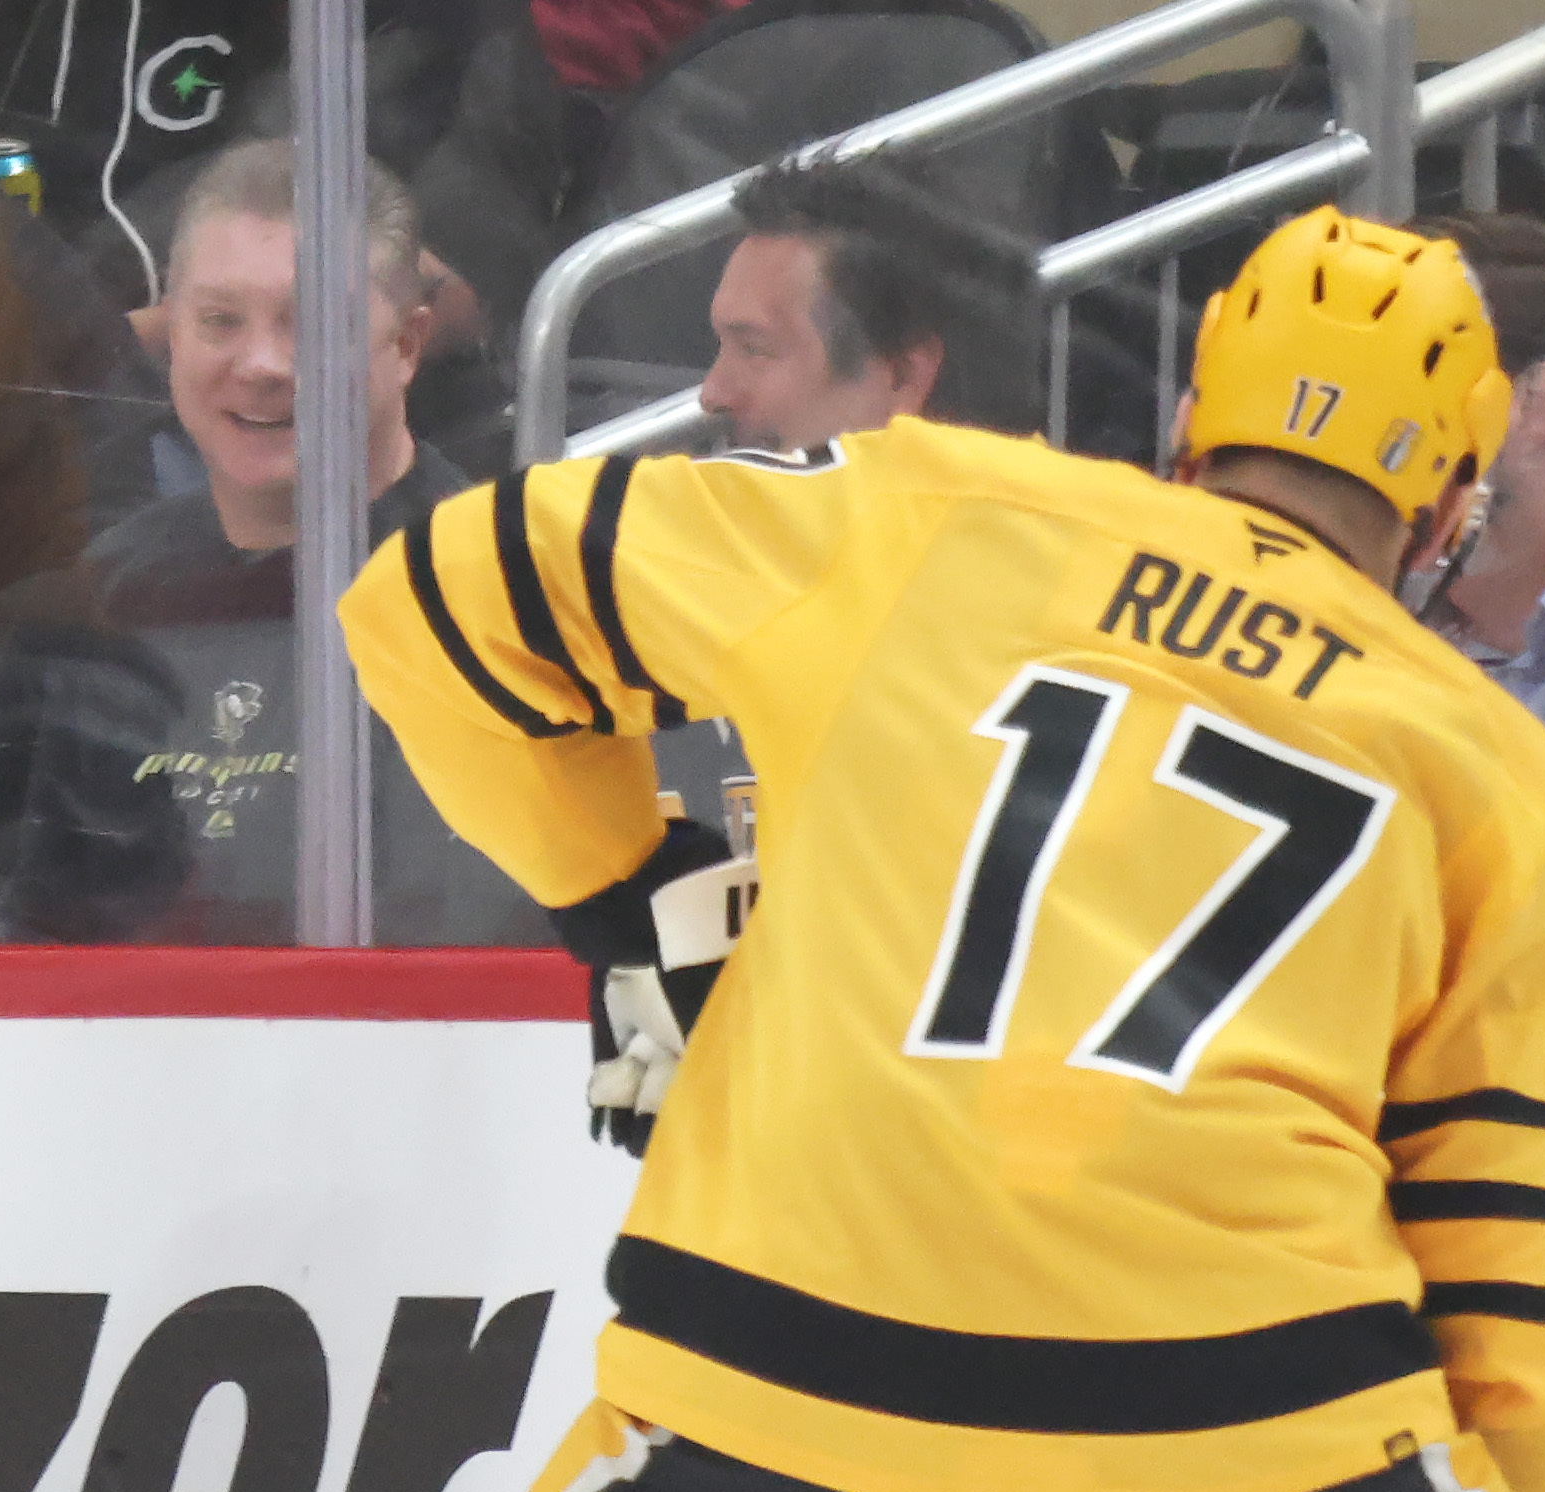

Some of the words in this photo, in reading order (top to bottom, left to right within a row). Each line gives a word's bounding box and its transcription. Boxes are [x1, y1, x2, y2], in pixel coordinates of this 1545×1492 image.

[1283, 376, 1345, 440] 17
[1096, 551, 1365, 701] RUST
[902, 663, 1398, 1095] 17
